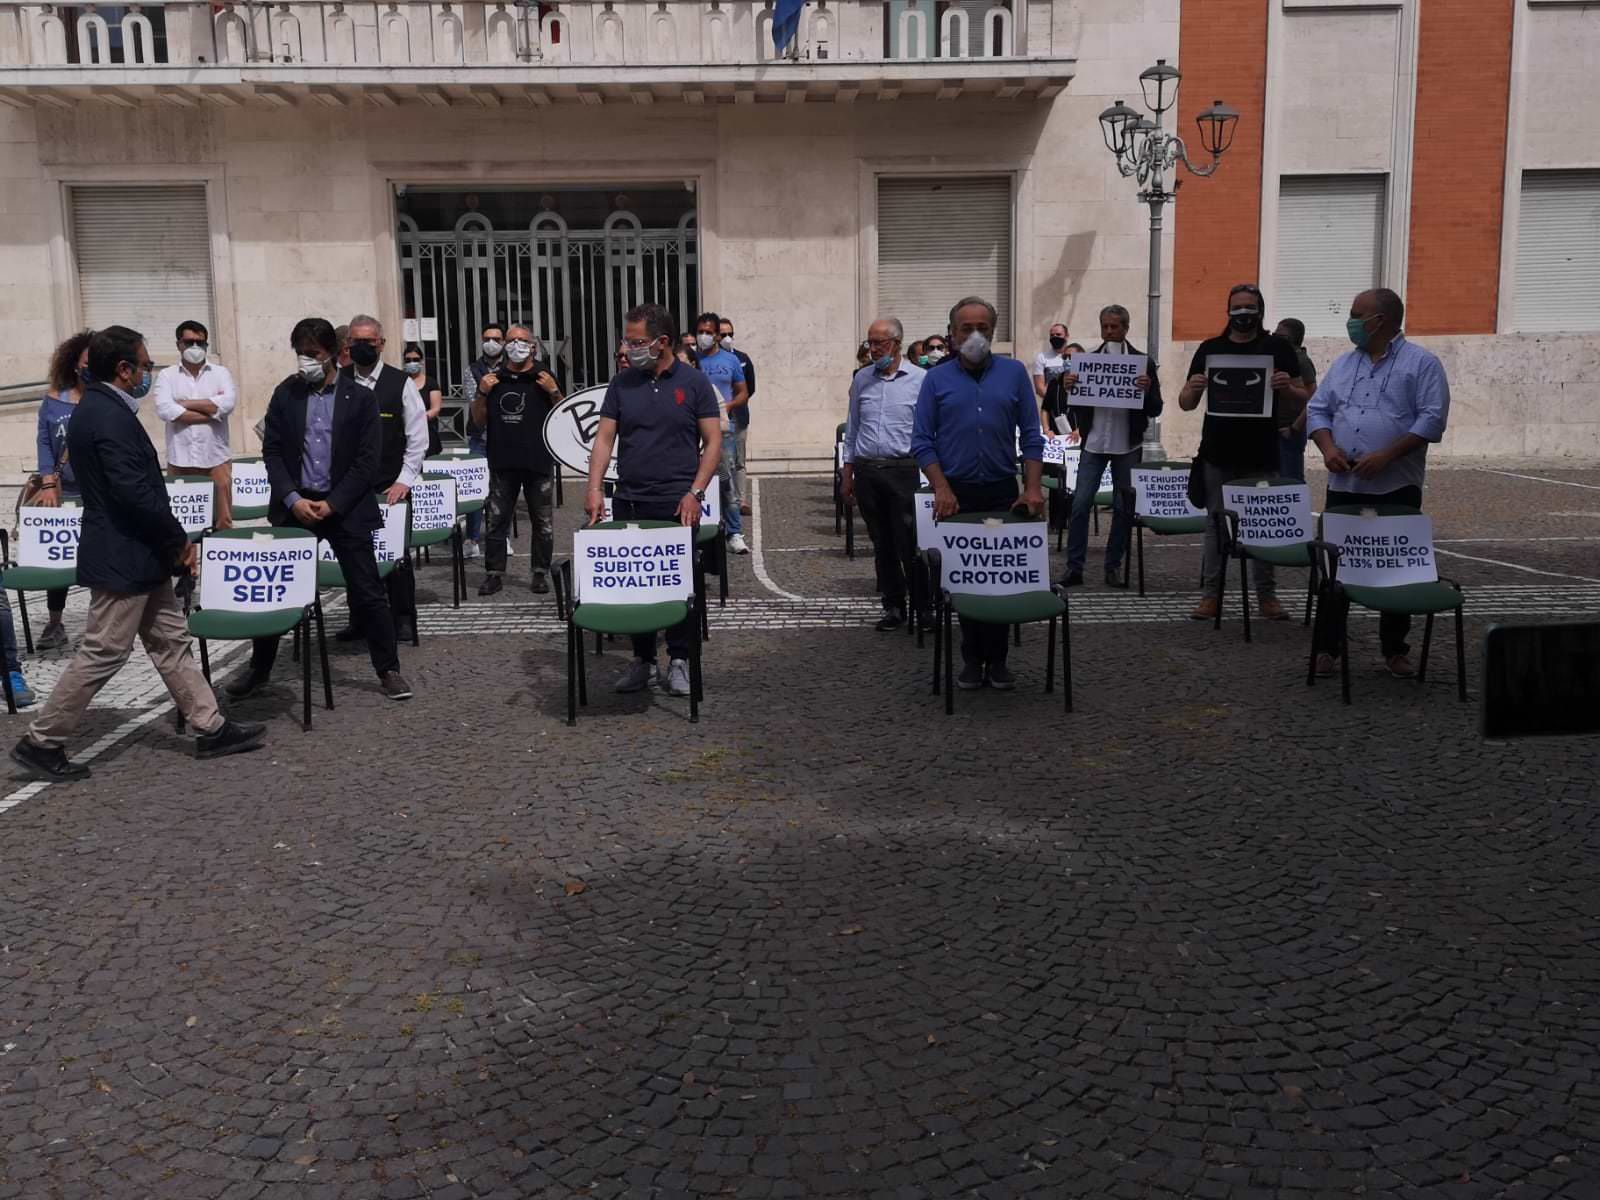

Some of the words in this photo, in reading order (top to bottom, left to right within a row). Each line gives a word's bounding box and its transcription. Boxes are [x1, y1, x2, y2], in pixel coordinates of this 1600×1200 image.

[1079, 361, 1137, 374] IMPRESE
[1071, 386, 1095, 397] DEL
[1099, 387, 1142, 399] PAESE
[236, 486, 253, 494] NO
[425, 483, 441, 492] NOI
[1231, 494, 1245, 504] LE
[1248, 493, 1302, 504] IMPRESE
[192, 504, 205, 513] LE
[1245, 505, 1290, 516] HANNO
[424, 513, 453, 522] SIAMO
[1240, 516, 1297, 527] BISOGNO
[1248, 528, 1304, 539] DIALOGO
[943, 535, 1043, 550] VOGLIAMO
[1344, 534, 1390, 546] ANCHE
[1394, 535, 1409, 545] IO
[206, 550, 313, 562] COMMISSARIO
[586, 544, 686, 558] SBLOCCARE
[594, 560, 655, 573] SUBITO
[660, 559, 679, 571] LE
[960, 553, 1028, 567] VIVERE
[1349, 559, 1373, 568] 13%
[1376, 559, 1405, 569] DEL
[1407, 557, 1430, 567] PIL
[223, 564, 294, 582] DOVE
[949, 570, 1040, 584] CROTONE
[592, 574, 681, 588] ROYALTIES
[233, 585, 287, 603] SEI?
